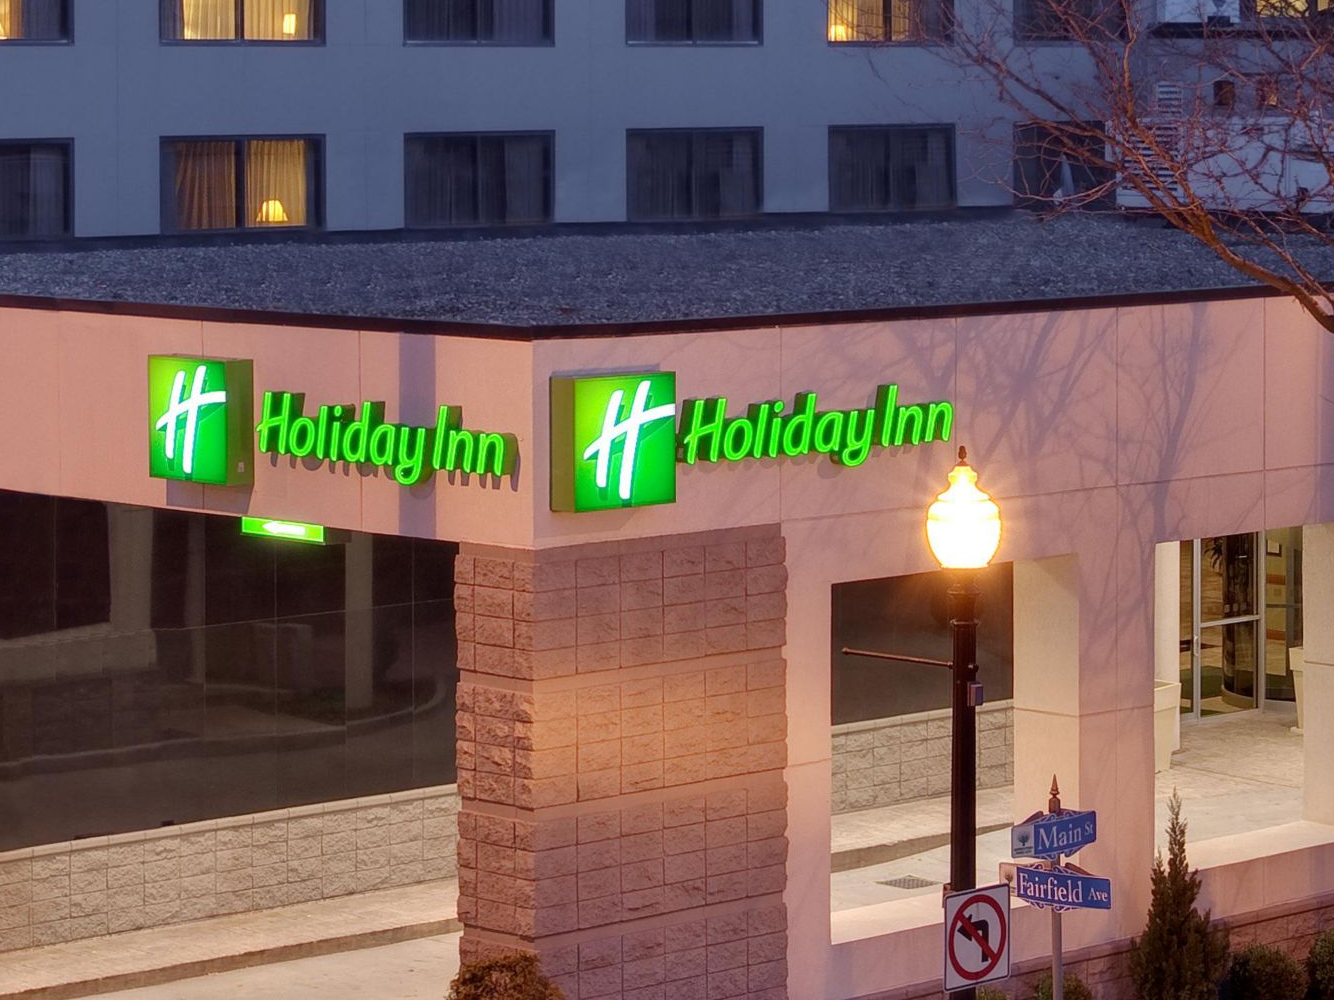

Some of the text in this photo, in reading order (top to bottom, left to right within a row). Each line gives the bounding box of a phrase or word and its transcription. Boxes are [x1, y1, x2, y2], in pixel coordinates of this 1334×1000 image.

[256, 391, 504, 485] Holiday Inn
[683, 384, 954, 467] Holiday Inn
[1038, 821, 1094, 850] Main St
[1018, 872, 1108, 903] Fairfield Ave
